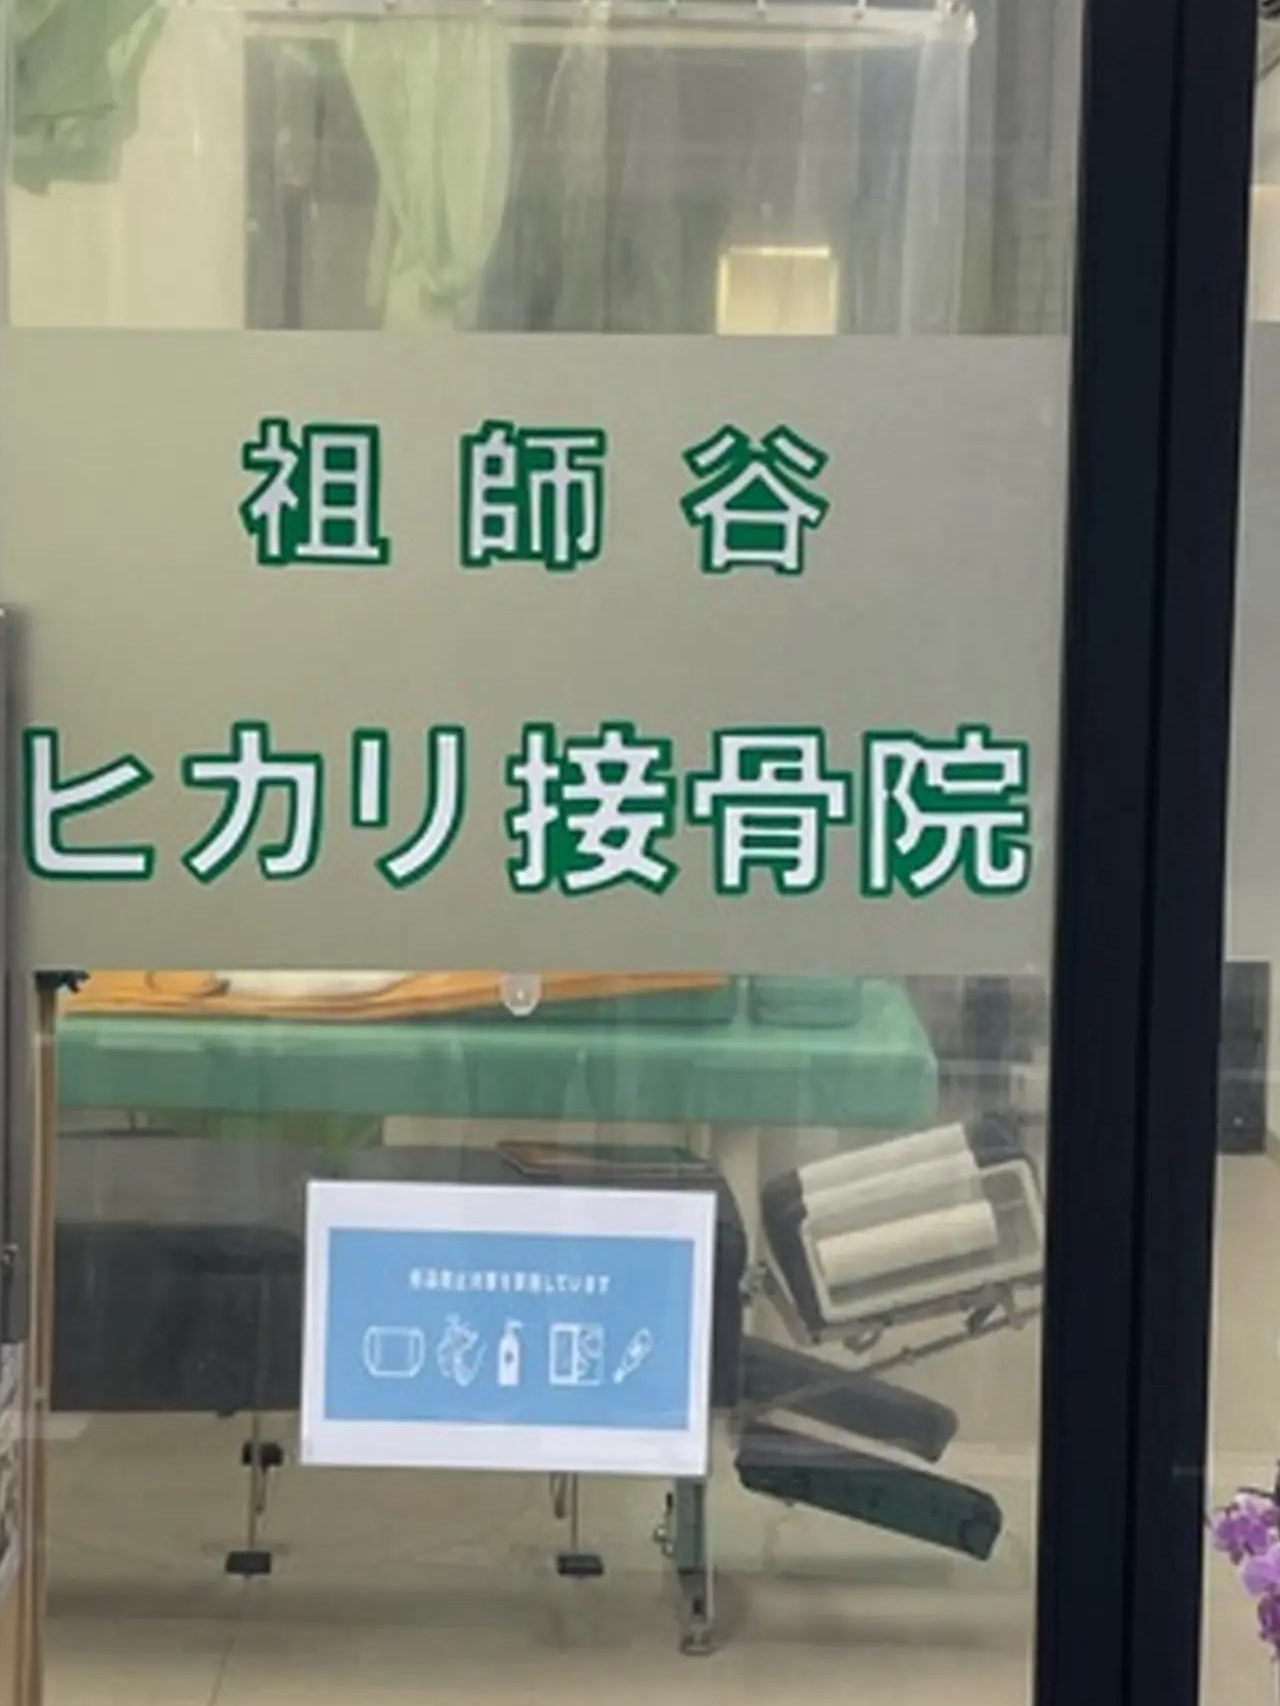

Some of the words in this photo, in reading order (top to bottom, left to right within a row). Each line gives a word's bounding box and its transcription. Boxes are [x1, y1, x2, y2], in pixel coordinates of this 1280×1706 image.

[238, 418, 832, 576] 祖師谷
[20, 721, 1032, 896] ヒカリ接骨院
